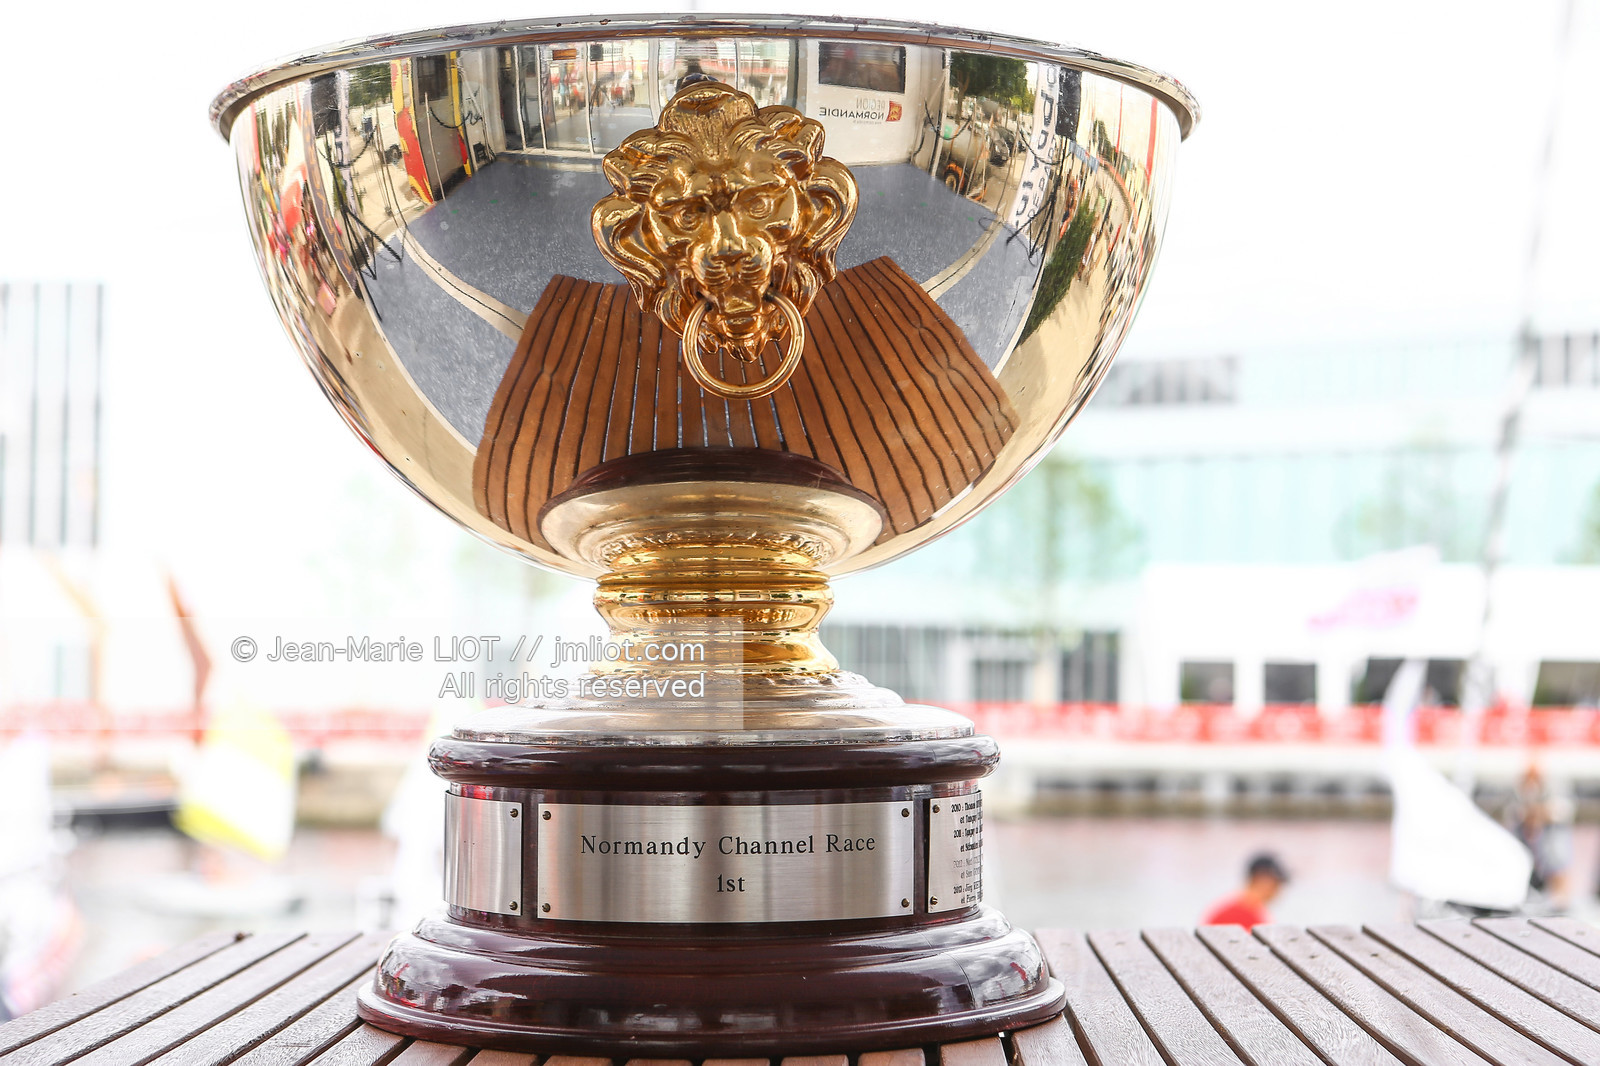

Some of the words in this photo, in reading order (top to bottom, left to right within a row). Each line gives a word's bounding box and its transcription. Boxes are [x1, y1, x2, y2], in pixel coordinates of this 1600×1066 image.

[581, 834, 706, 859] Normandy
[718, 834, 815, 856] Channel
[826, 834, 876, 853] Race
[716, 873, 746, 893] 1st
